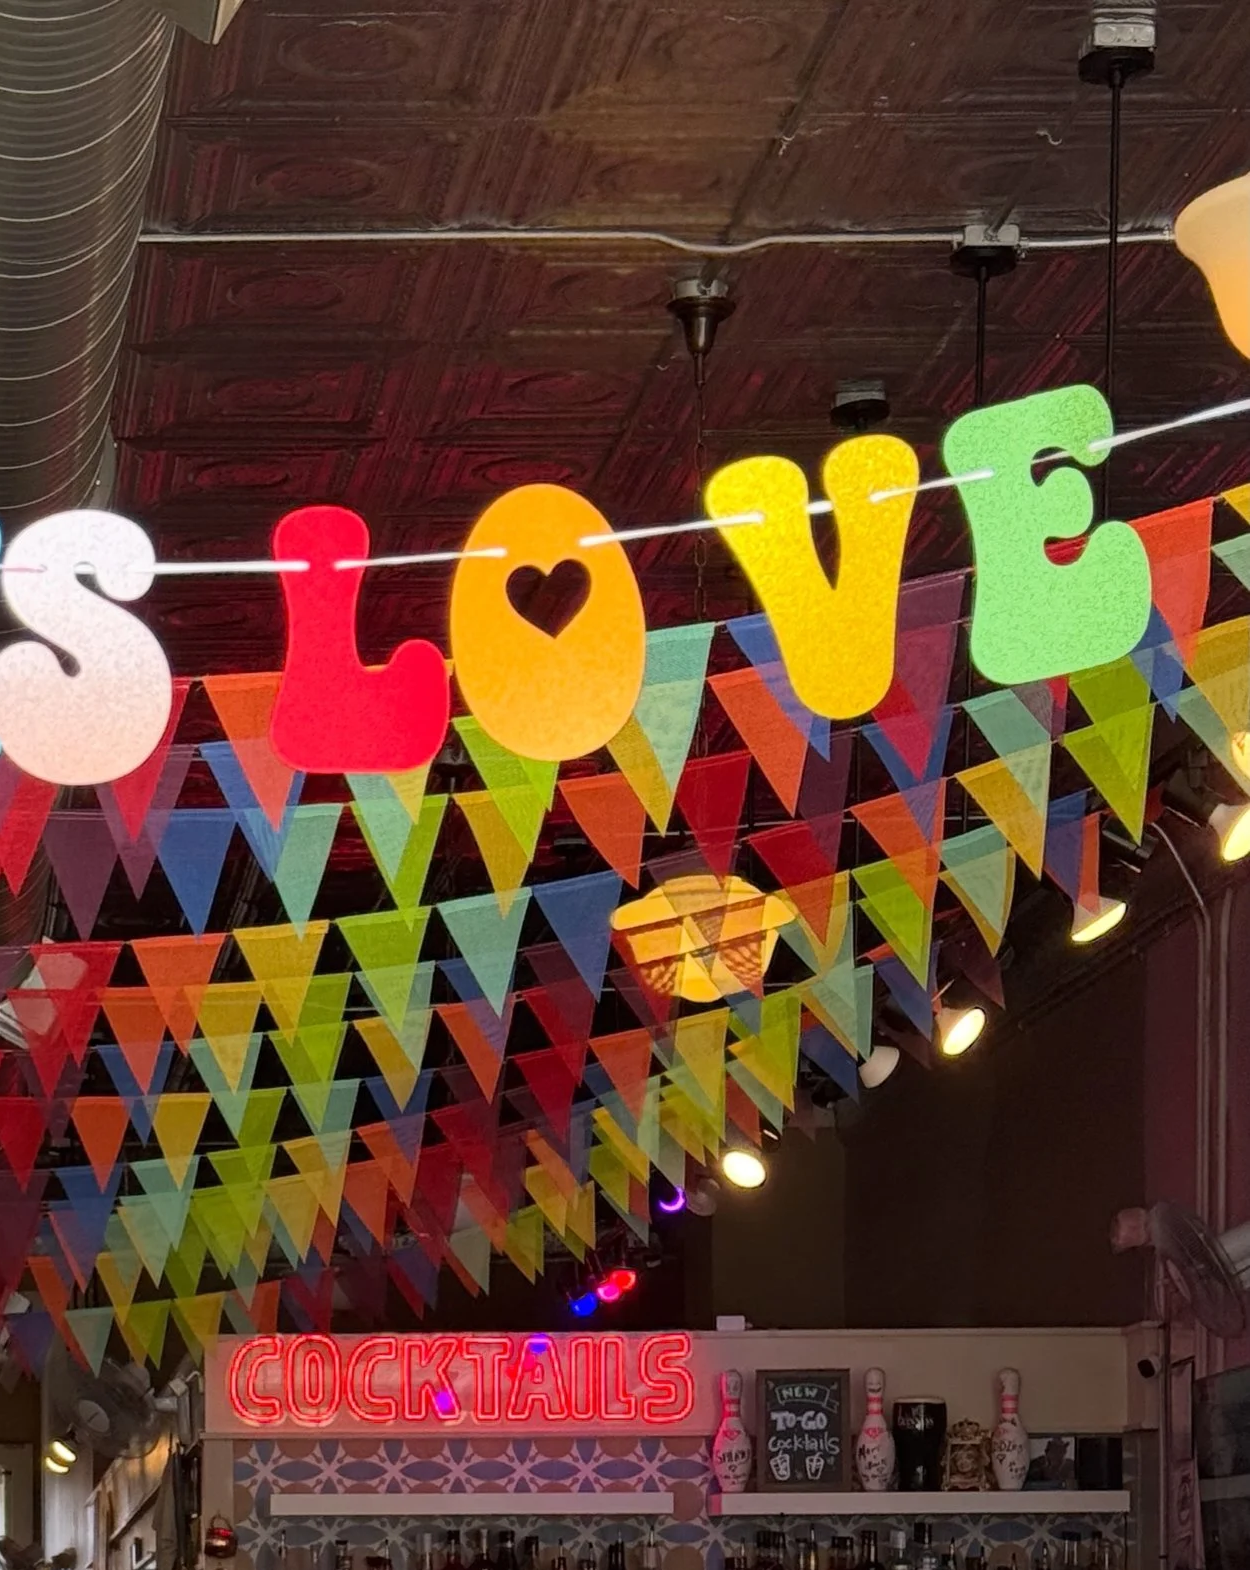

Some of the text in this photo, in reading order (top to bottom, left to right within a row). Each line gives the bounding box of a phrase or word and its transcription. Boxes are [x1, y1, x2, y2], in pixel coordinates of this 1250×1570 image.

[269, 384, 1152, 774] LOVE
[230, 1331, 695, 1426] COCKTAILS
[781, 1386, 818, 1398] NEW
[770, 1410, 828, 1431] TO-GO
